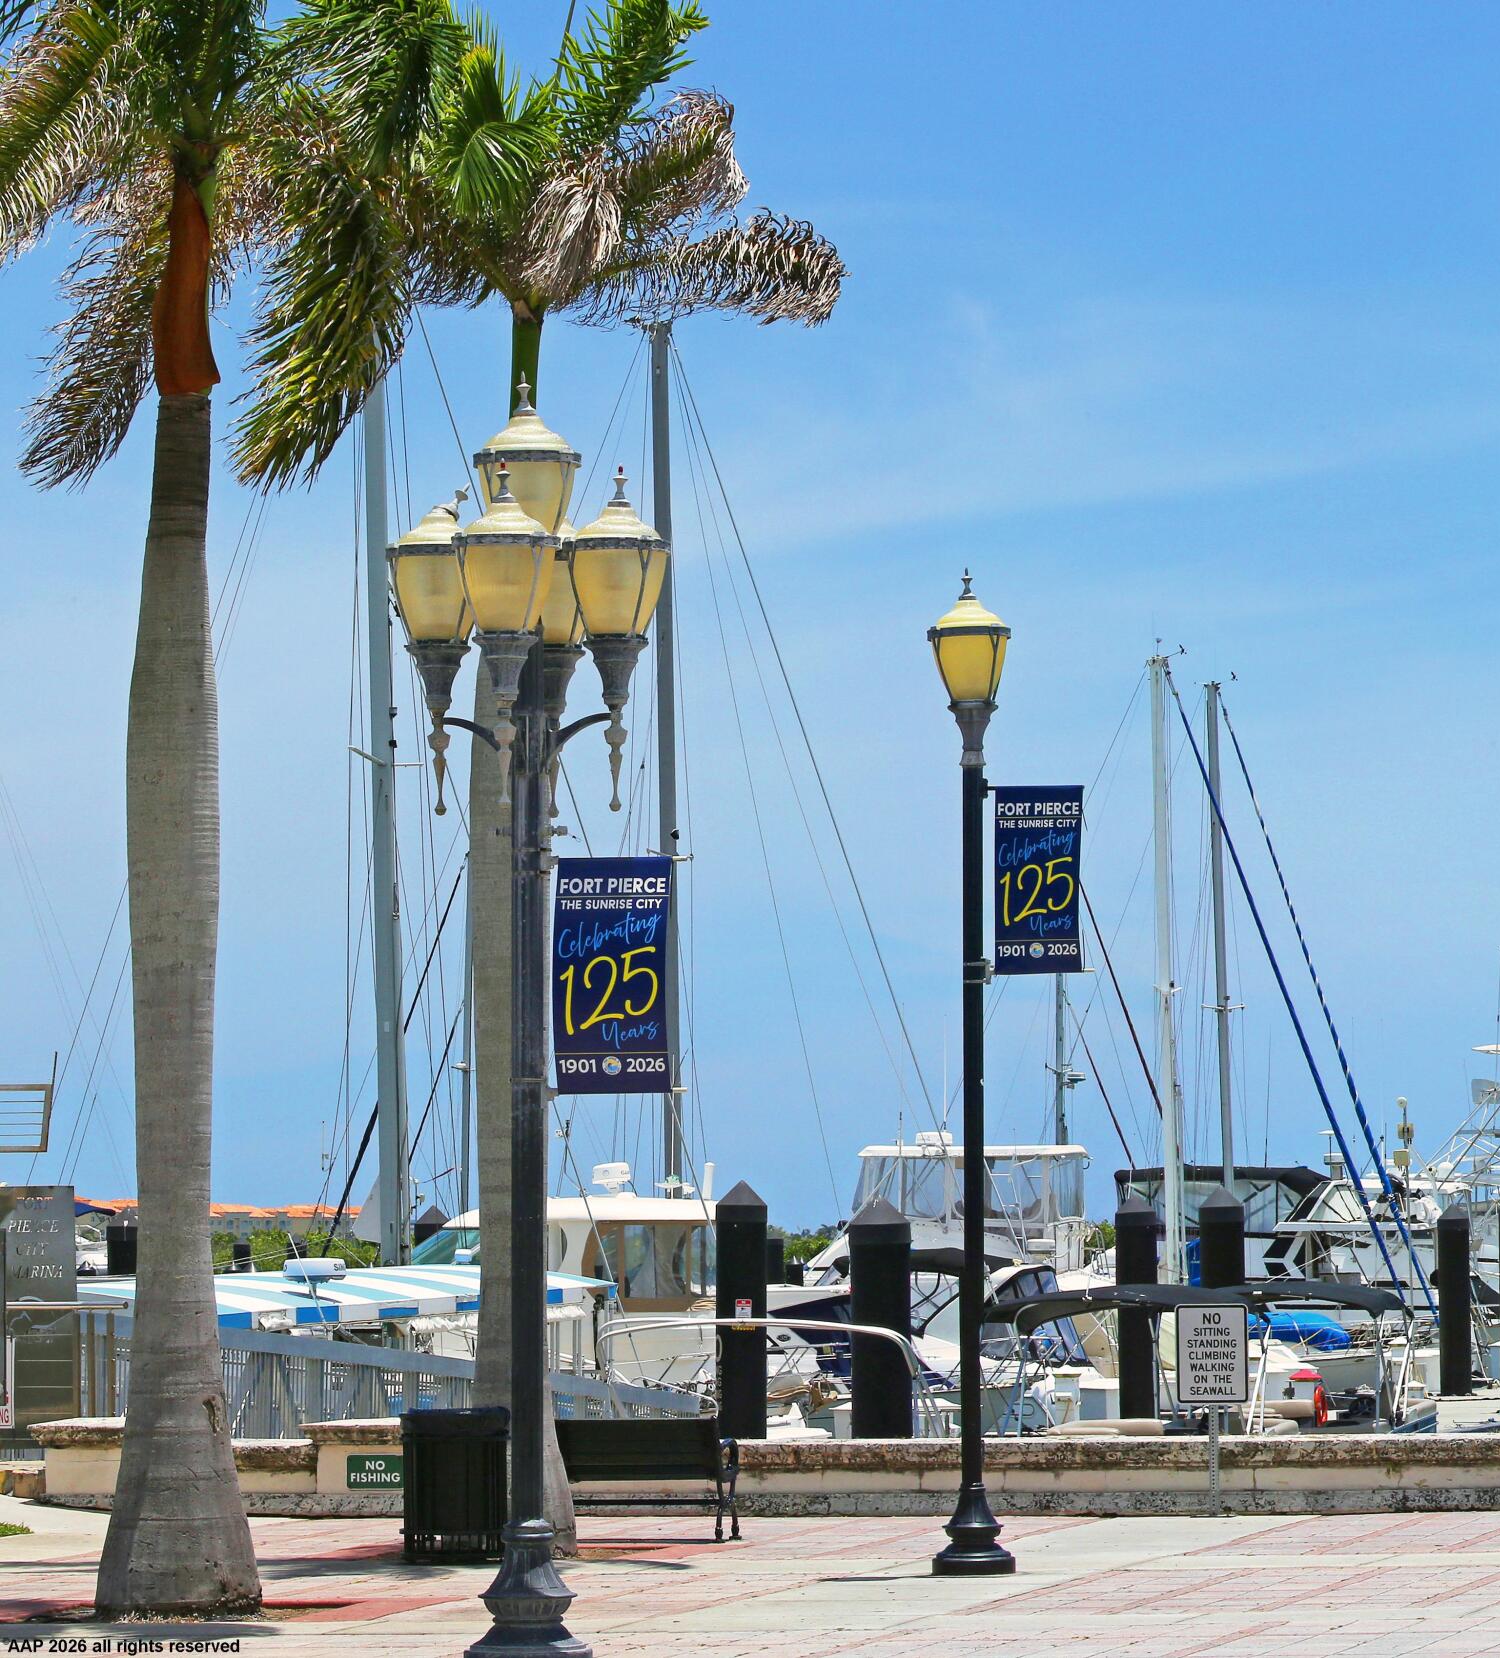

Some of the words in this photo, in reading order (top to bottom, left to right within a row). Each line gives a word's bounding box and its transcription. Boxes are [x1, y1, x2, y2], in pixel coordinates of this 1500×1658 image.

[997, 803, 1031, 816] FORT
[1034, 802, 1080, 815] PIERCE
[999, 820, 1015, 828] THE
[1017, 819, 1054, 828] SUNRISE
[1056, 819, 1077, 828] CITY
[998, 829, 1077, 867] Celebrating
[559, 877, 603, 894] FORT
[607, 877, 667, 894] PIERCE
[999, 856, 1075, 927] 125
[560, 899, 581, 910] THE
[585, 899, 633, 910] SUNRISE
[635, 898, 663, 909] CITY
[1030, 915, 1073, 937] Years
[558, 911, 662, 959] Celebrating
[998, 945, 1026, 957] 1901
[1047, 943, 1078, 956] 2026
[559, 946, 659, 1036] 125
[601, 1021, 659, 1050] Years
[559, 1058, 597, 1074] 1901
[626, 1057, 666, 1073] 2026
[1202, 1313, 1221, 1325] NO
[1193, 1328, 1230, 1337] SITTING
[1187, 1339, 1237, 1348] STANDING
[1189, 1351, 1236, 1360] CLIMBING
[1190, 1363, 1235, 1372] WALKING
[1194, 1375, 1208, 1384] ON
[1213, 1375, 1232, 1384] THE
[1190, 1387, 1236, 1396] SEAWALL
[365, 1460, 385, 1471] NO
[350, 1472, 401, 1483] FISHING
